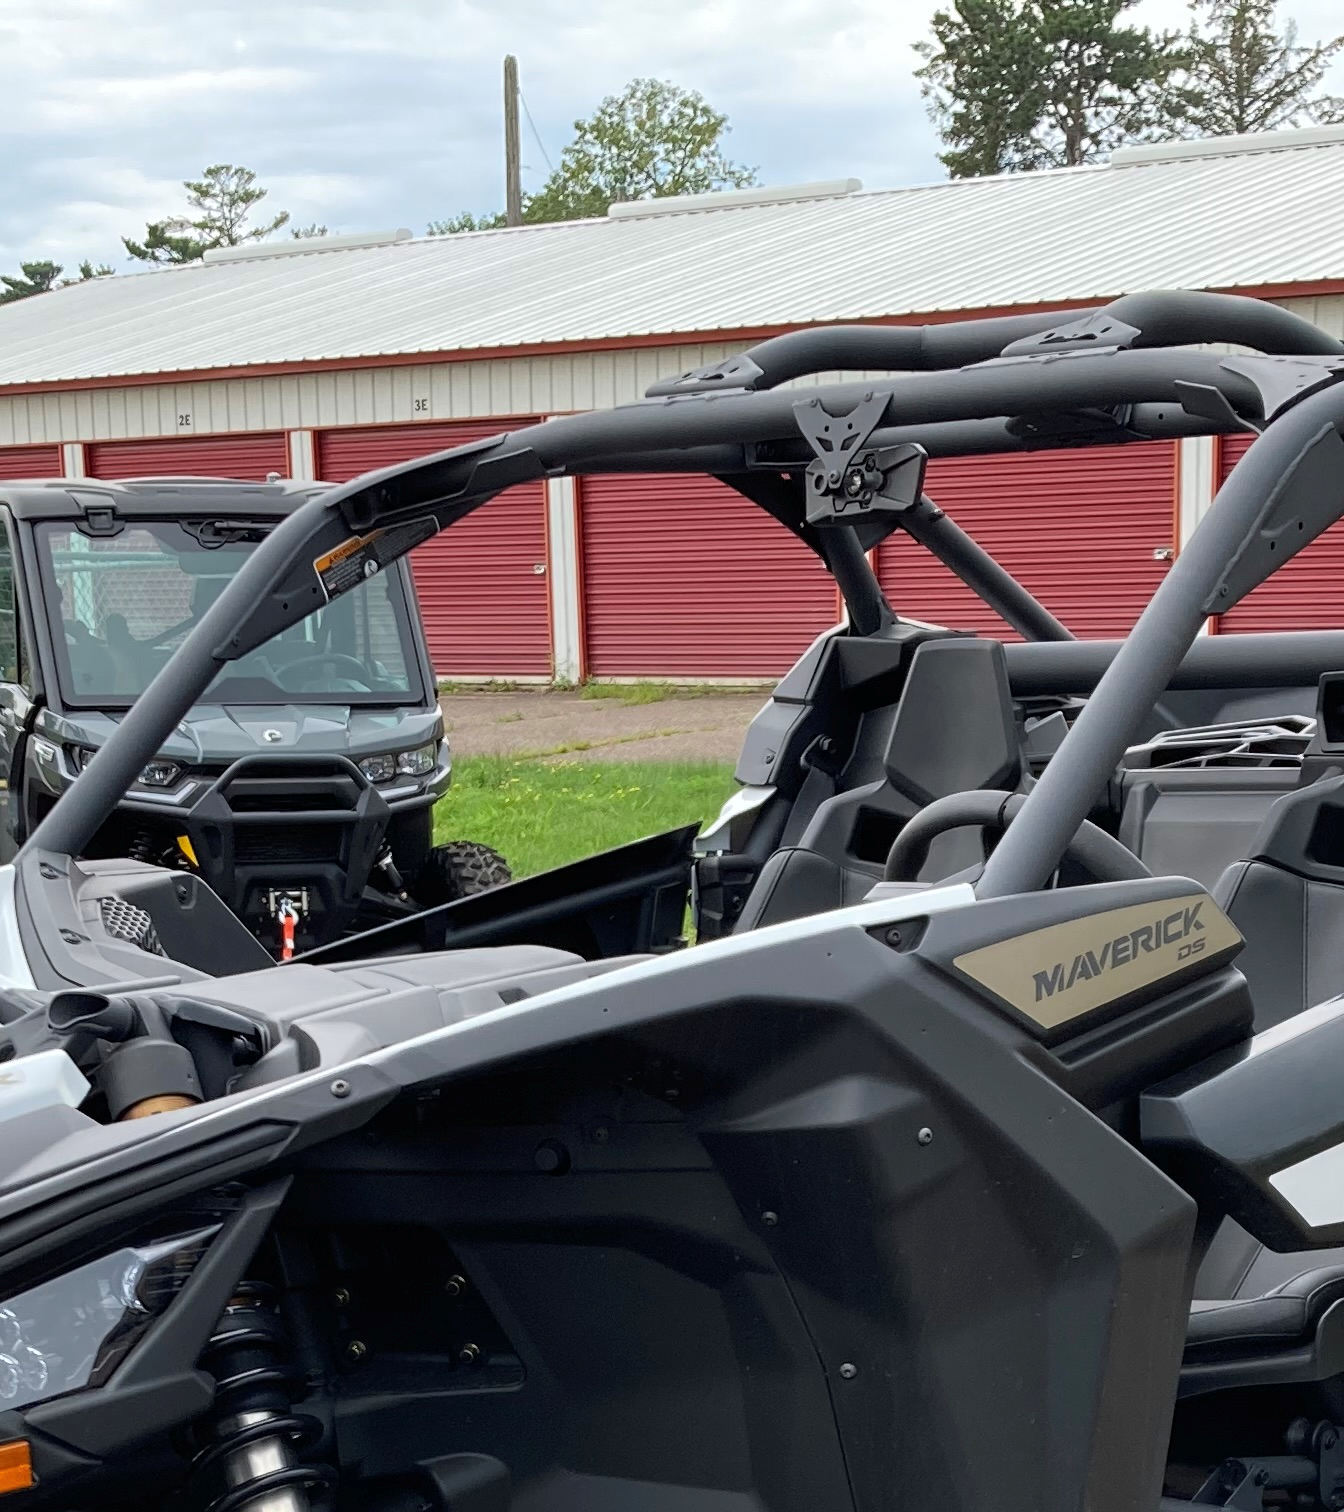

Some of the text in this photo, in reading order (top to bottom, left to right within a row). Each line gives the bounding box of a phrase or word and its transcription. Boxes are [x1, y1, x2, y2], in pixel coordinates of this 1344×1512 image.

[414, 399, 428, 411] 3E
[178, 414, 191, 426] 2E
[1032, 901, 1206, 1003] MAVERICK
[1177, 937, 1206, 961] DS
